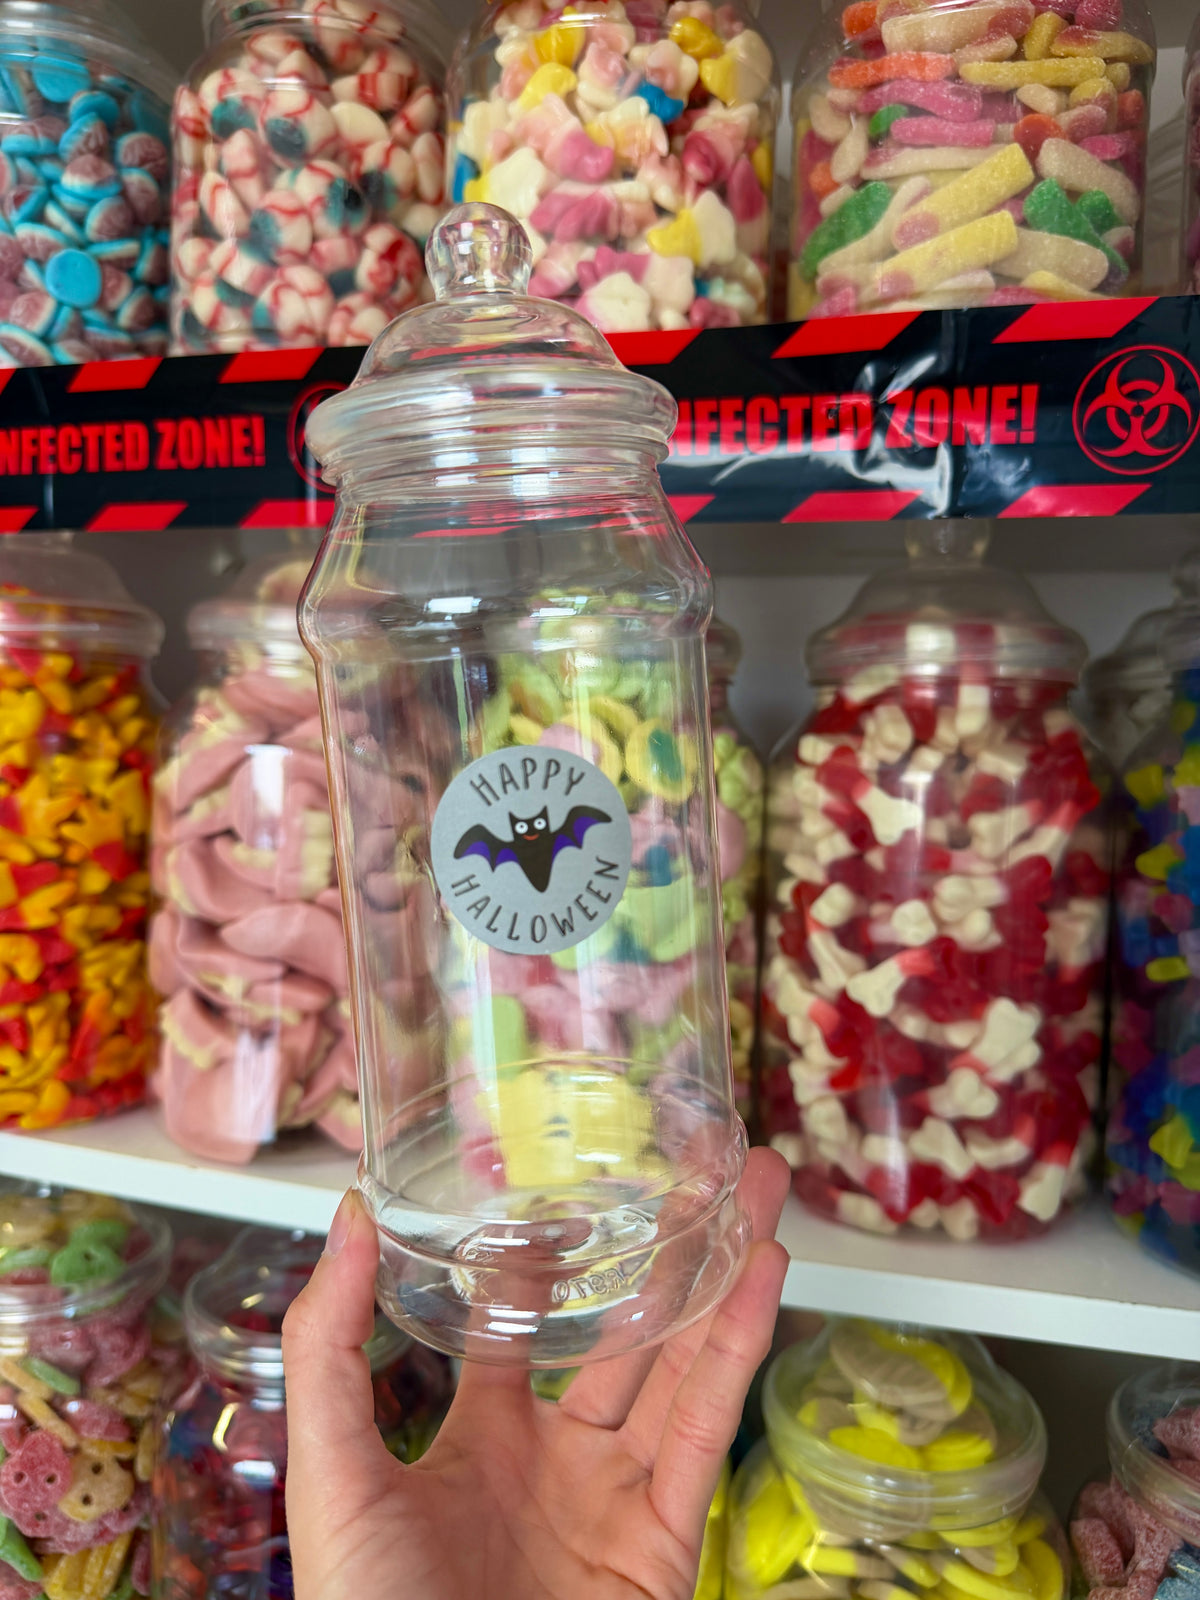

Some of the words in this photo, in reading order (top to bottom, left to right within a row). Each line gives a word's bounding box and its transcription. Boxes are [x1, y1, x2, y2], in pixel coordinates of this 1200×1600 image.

[155, 415, 266, 470] ZONE!
[884, 383, 1040, 449] ZONE!
[470, 757, 585, 806] HAPPY
[450, 856, 620, 944] HALLOWEEN
